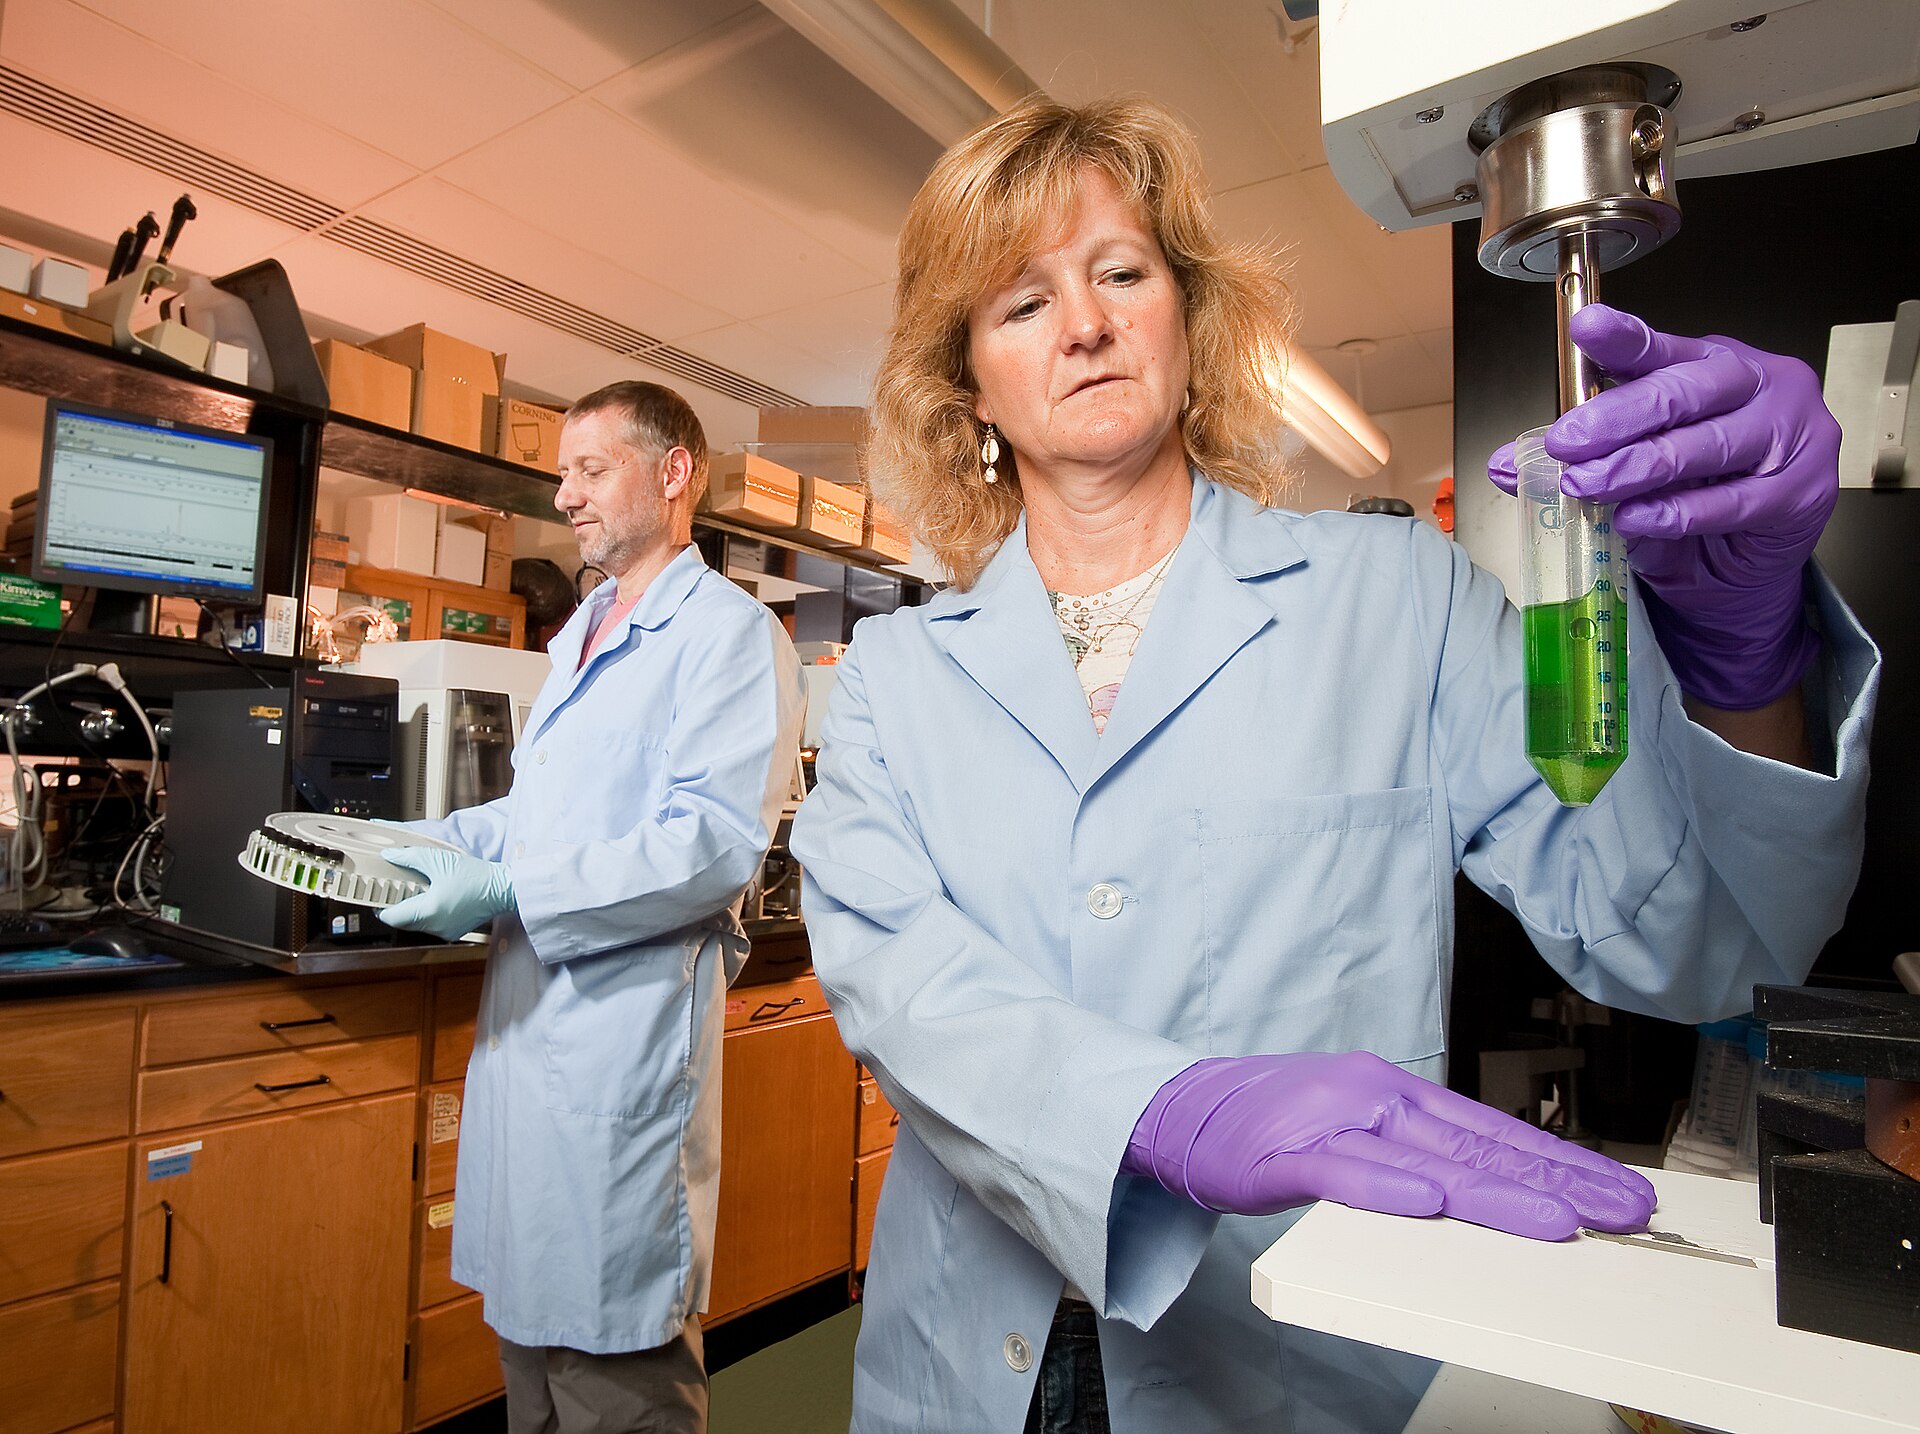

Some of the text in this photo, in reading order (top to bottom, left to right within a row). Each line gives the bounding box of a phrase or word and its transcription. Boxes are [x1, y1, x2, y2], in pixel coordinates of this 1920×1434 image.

[511, 404, 556, 422] CORNING
[157, 418, 174, 428] IBM
[1595, 523, 1610, 534] 40
[1596, 551, 1610, 562] 35
[1596, 580, 1611, 591] 30
[1597, 610, 1611, 621] 25
[1597, 641, 1611, 652] 20
[1598, 672, 1611, 683] 15
[1598, 702, 1612, 713] 10
[1605, 734, 1612, 746] 5
